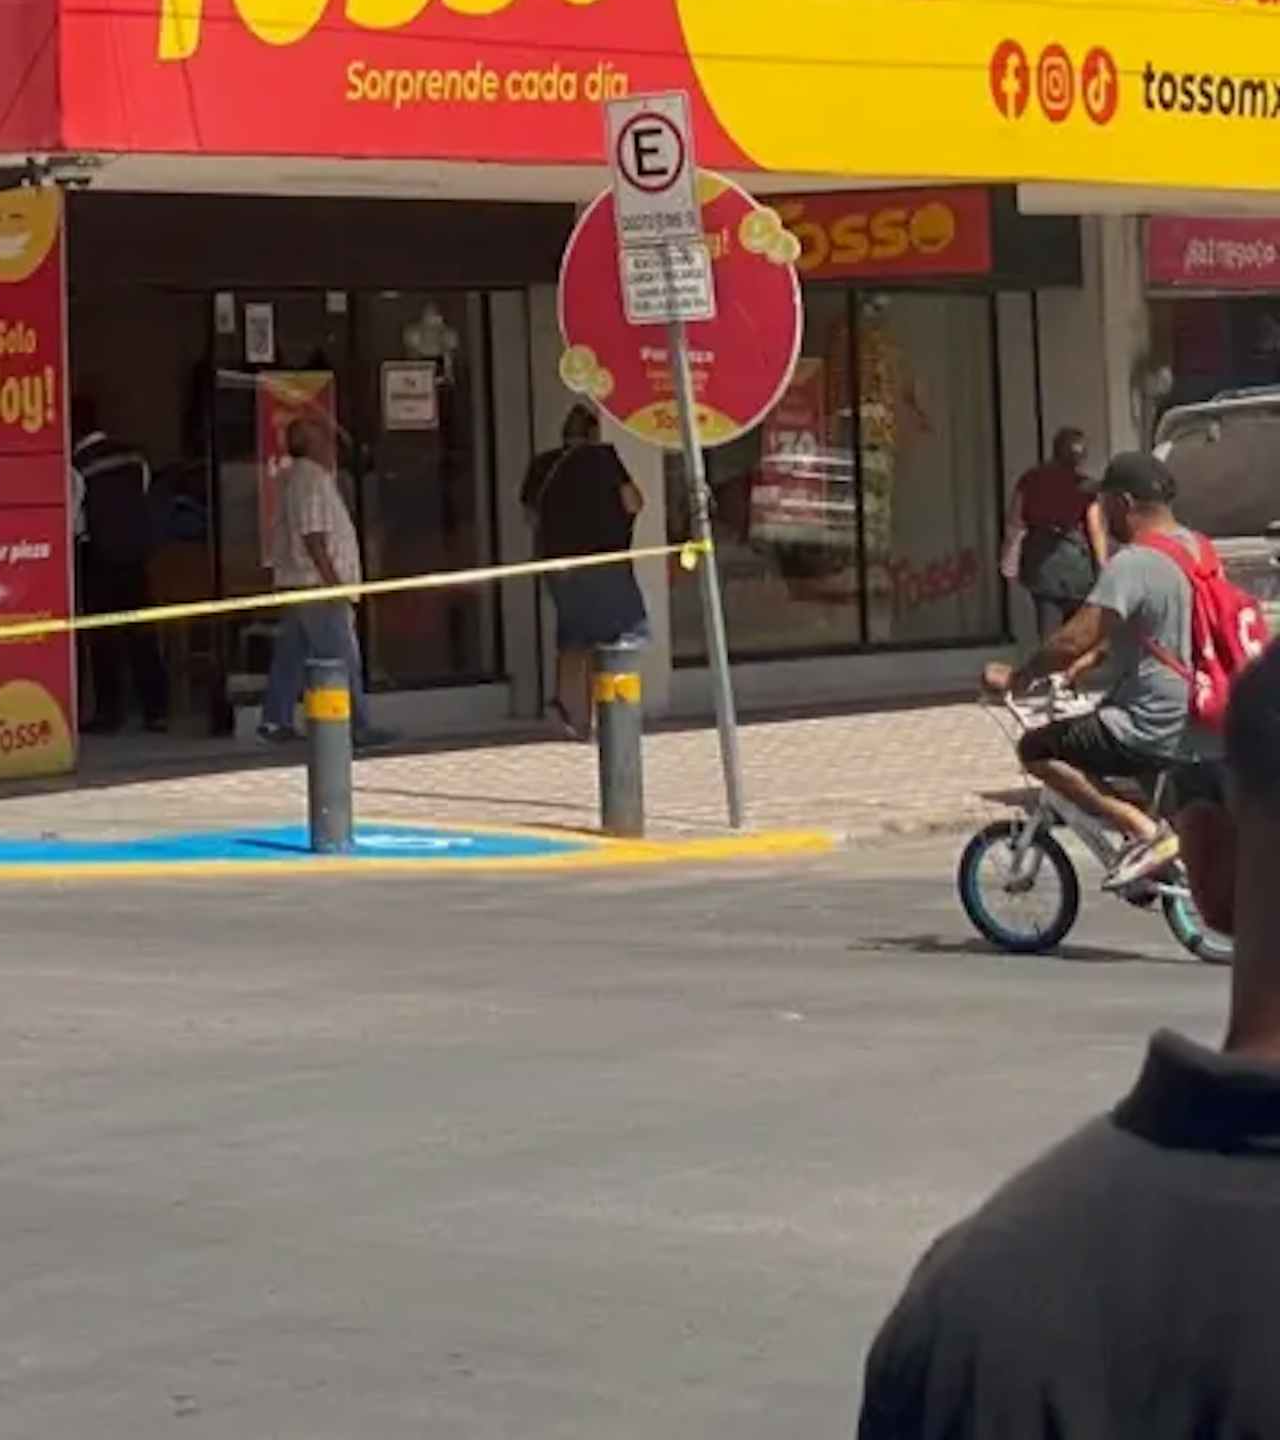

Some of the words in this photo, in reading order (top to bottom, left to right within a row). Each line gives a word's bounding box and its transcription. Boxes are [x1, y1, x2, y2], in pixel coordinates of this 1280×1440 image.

[345, 60, 499, 110] Sorprende
[506, 61, 578, 101] cada
[585, 59, 629, 100] día
[632, 127, 669, 178] E
[778, 201, 956, 269] osso
